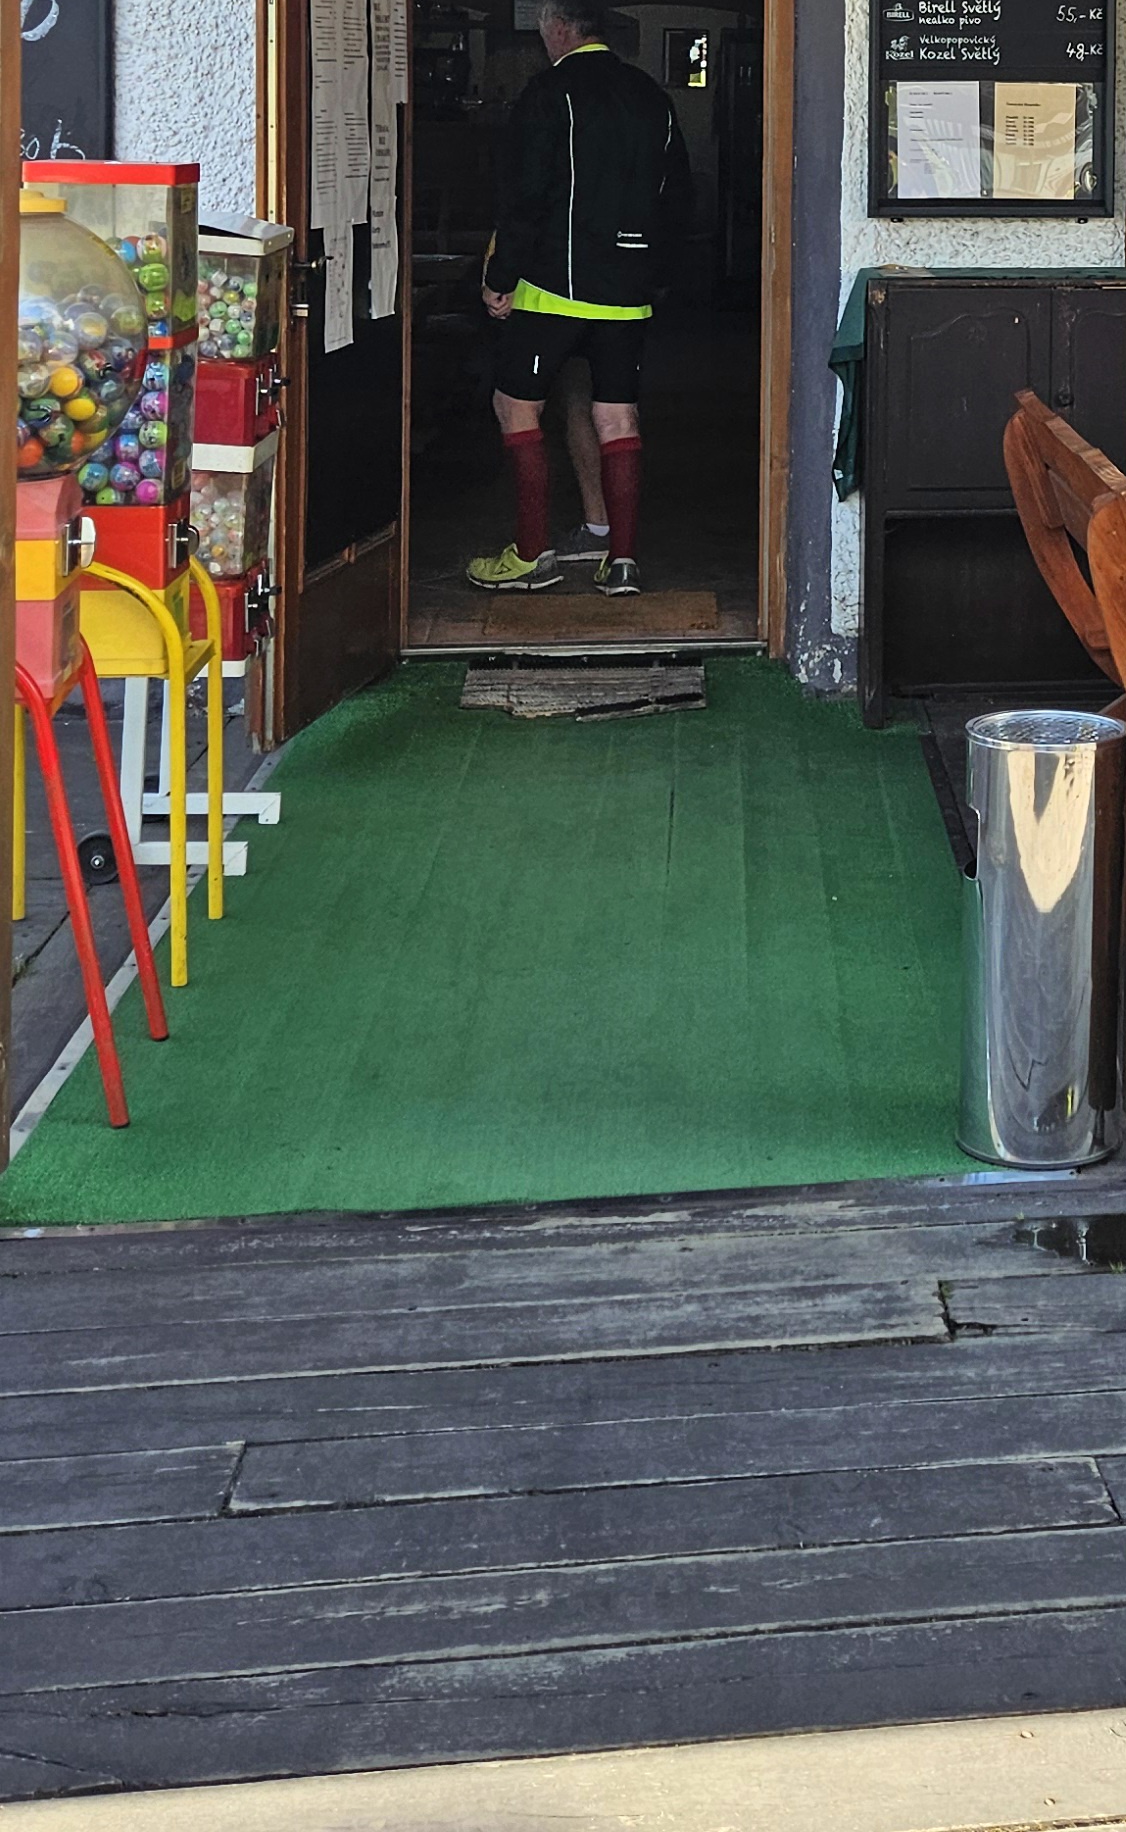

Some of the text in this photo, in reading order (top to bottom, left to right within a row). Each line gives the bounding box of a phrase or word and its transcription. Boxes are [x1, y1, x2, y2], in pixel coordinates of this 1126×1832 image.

[918, 0, 1001, 21] Birell Světlý
[1089, 7, 1103, 20] Kč
[918, 15, 982, 30] nealko pivo
[885, 48, 914, 60] Kozel
[919, 44, 1000, 65] Kozel Světlý
[1089, 43, 1103, 55] Kč
